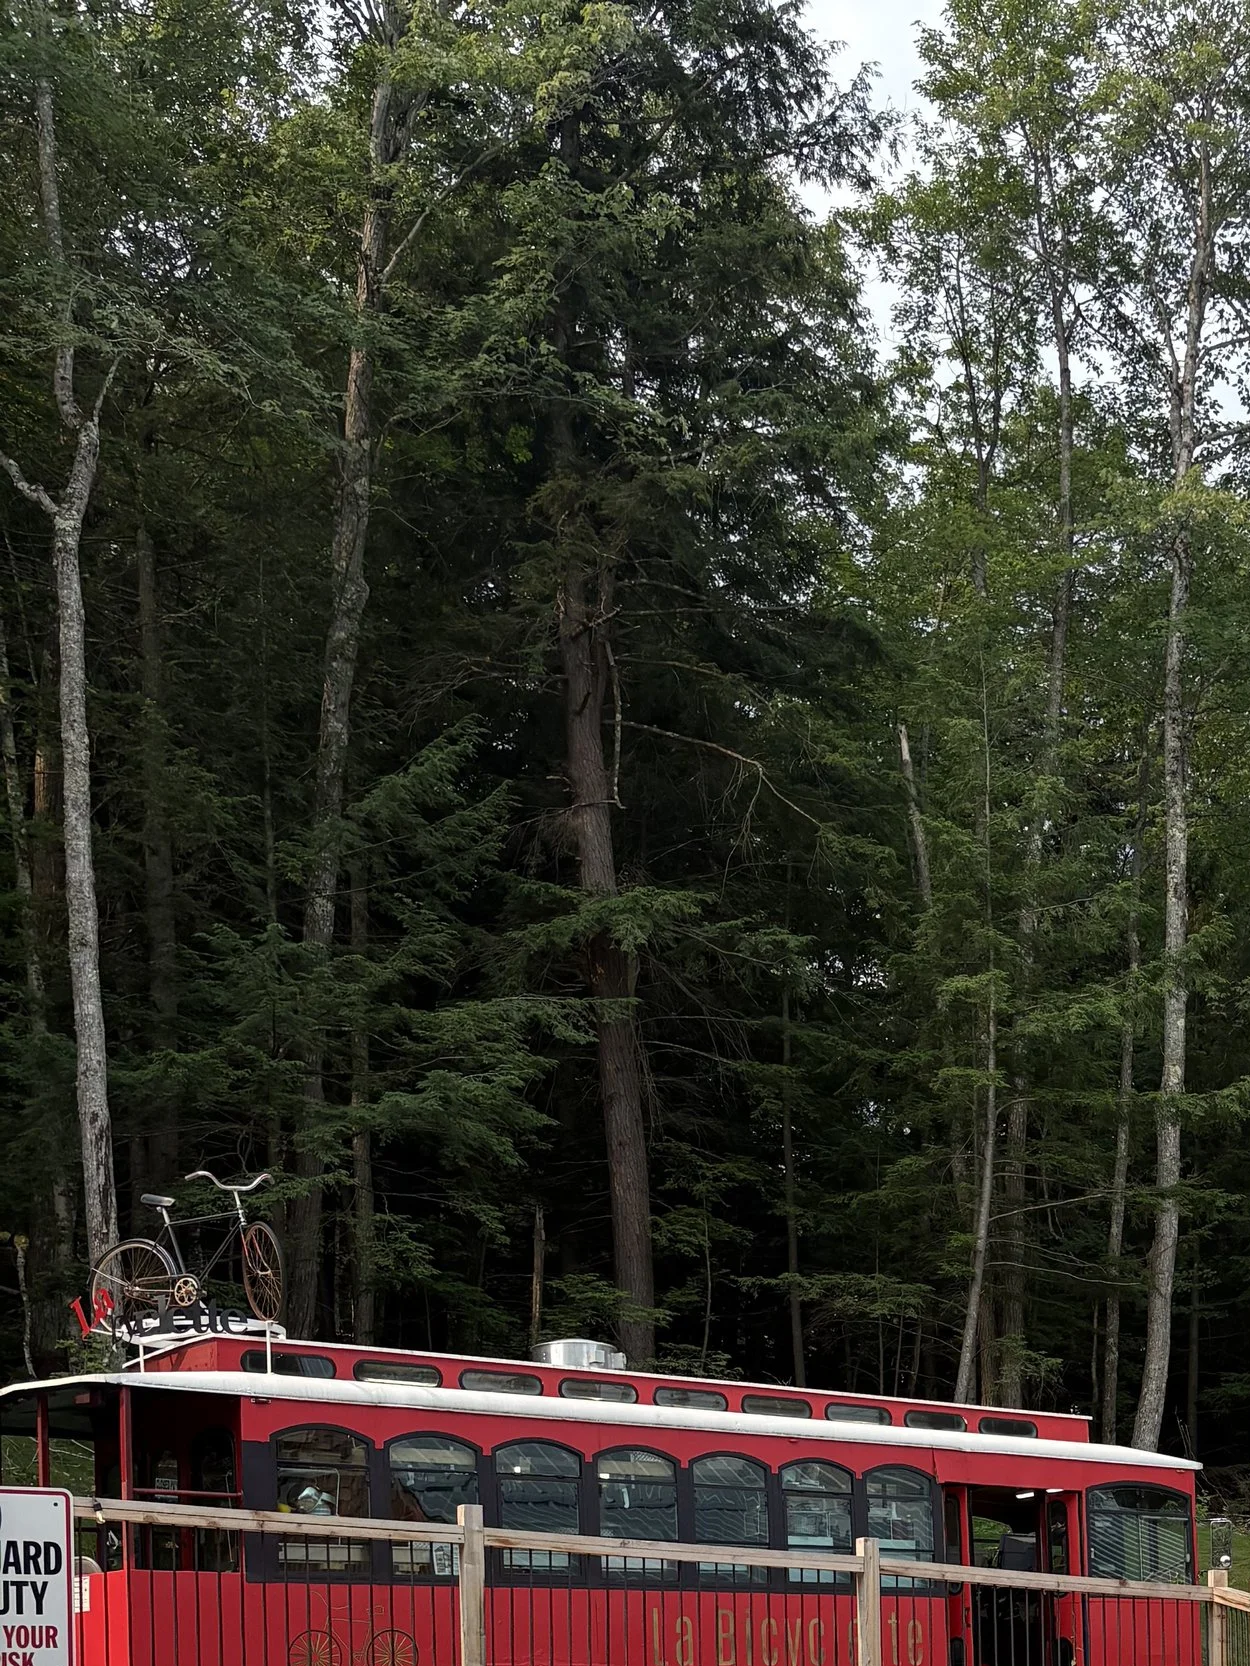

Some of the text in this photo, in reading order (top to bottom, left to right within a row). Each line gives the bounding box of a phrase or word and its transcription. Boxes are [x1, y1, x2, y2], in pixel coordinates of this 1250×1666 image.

[0, 1540, 63, 1575] ARD
[2, 1624, 59, 1649] YOUR
[652, 1607, 694, 1666] La
